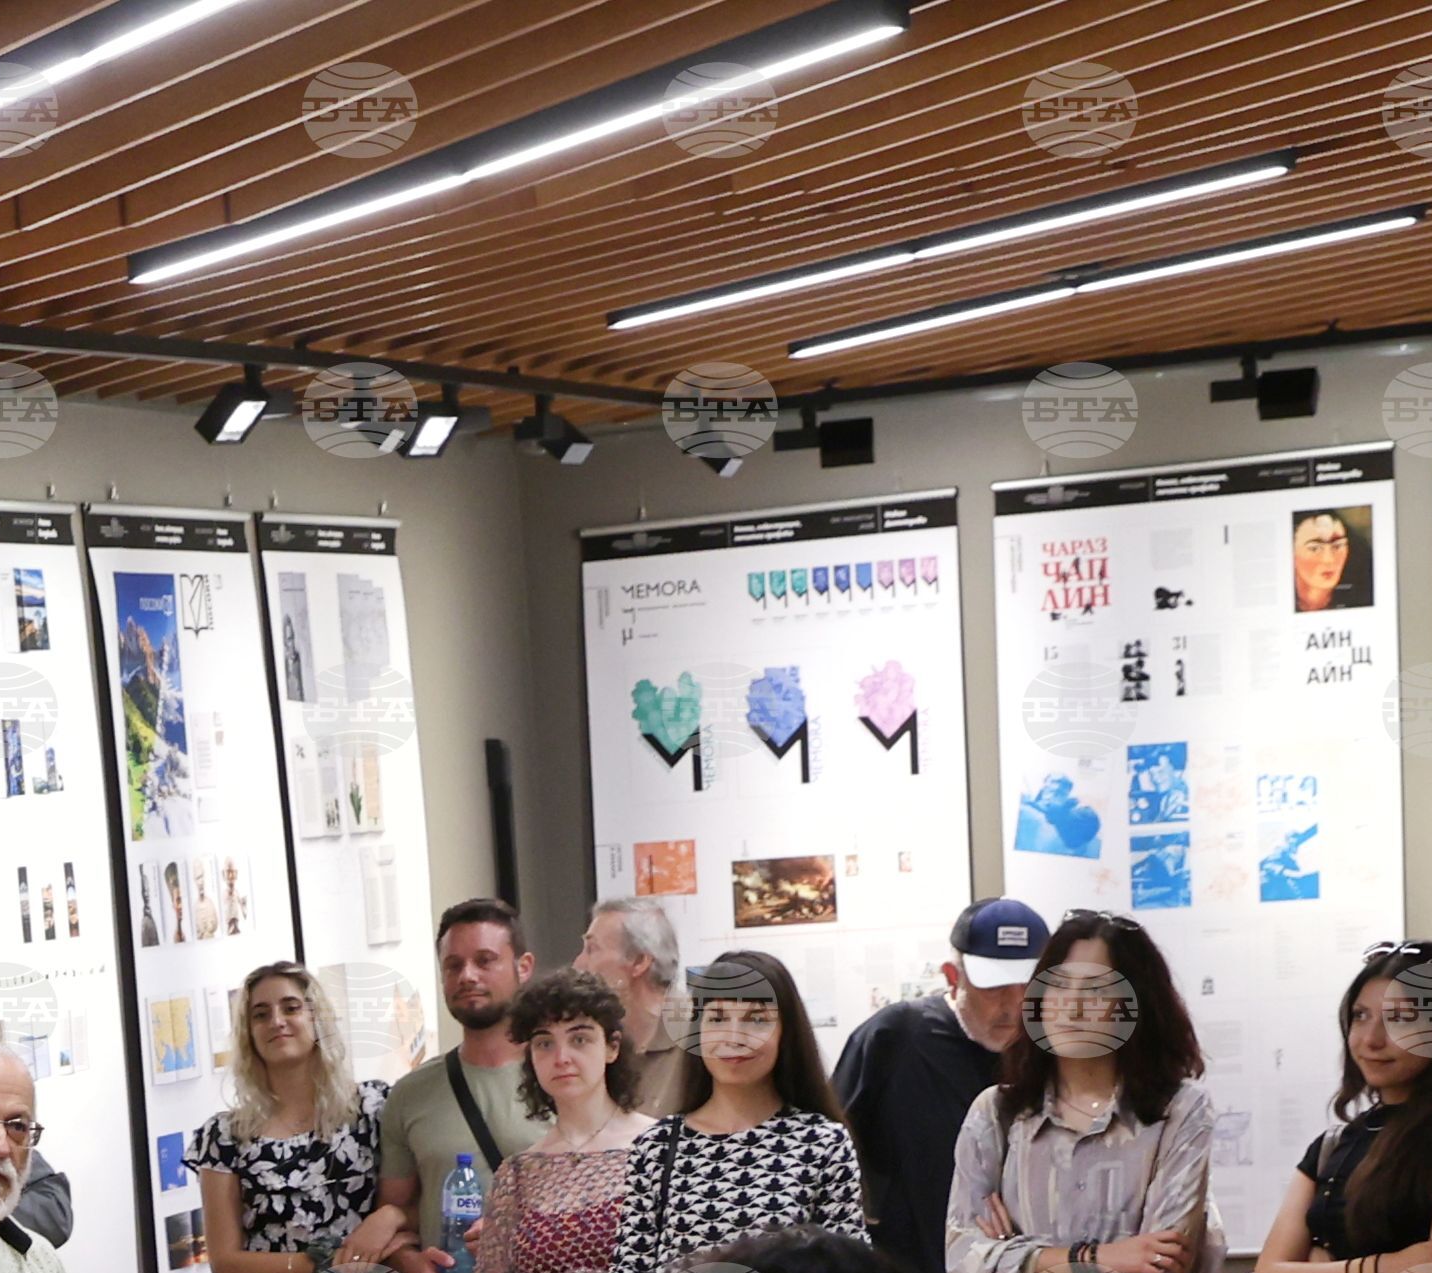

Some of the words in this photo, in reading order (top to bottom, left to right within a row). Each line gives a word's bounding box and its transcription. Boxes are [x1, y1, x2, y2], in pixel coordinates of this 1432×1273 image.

[1042, 537, 1108, 557] ЧАРЛЗ
[1041, 557, 1110, 584] ЧАП
[1041, 584, 1111, 611] ЛИН
[1305, 626, 1352, 650] АЙН
[1307, 660, 1352, 685] АЙН
